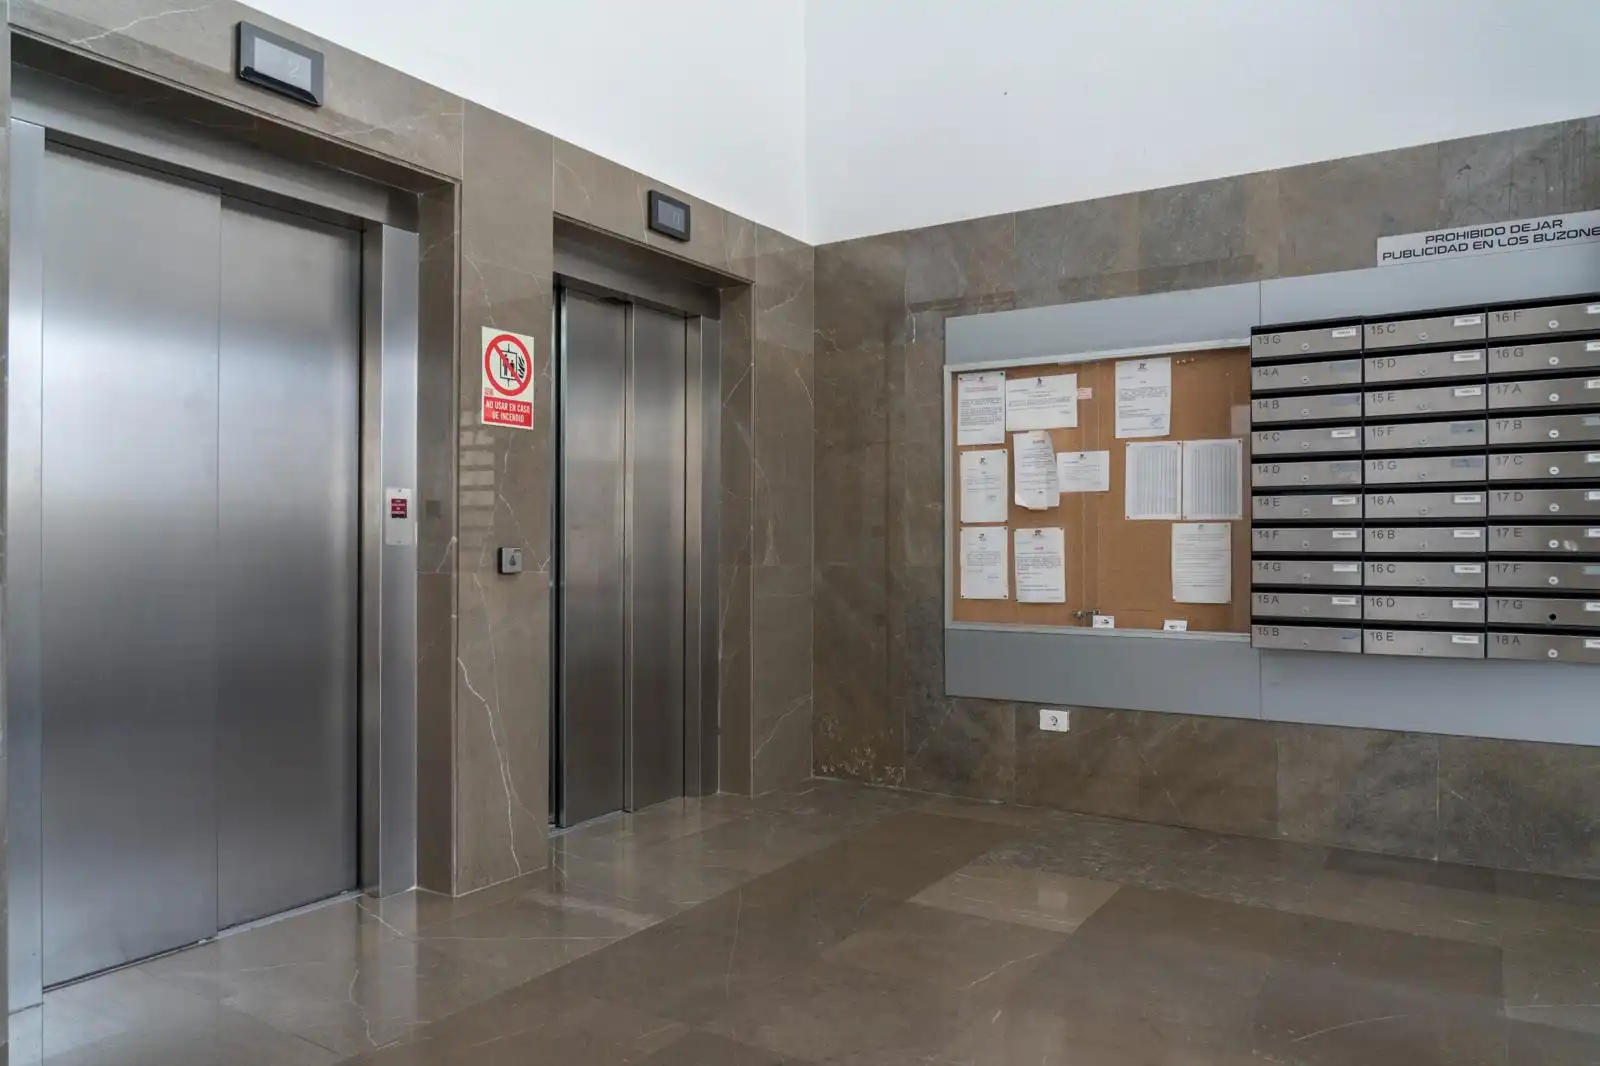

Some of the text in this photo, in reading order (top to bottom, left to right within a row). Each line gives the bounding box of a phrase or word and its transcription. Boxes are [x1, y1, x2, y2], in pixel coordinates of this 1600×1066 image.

[1425, 219, 1563, 244] PROHIBIDO DEJAR
[1382, 226, 1600, 260] PUBLICIDAD EN LOS BUZONE
[1495, 312, 1523, 323] 16 F
[1371, 324, 1396, 334] 15 C
[1495, 348, 1524, 359] 16 G
[1371, 359, 1396, 369] 15 D
[1257, 368, 1279, 377] 14 A
[1495, 384, 1522, 395] 17 A
[1371, 392, 1395, 403] 15 E
[486, 400, 530, 413] NO USAR EN CASO
[1257, 400, 1279, 409] 14 B
[492, 410, 524, 422] DE INCENDIO
[1496, 420, 1522, 429] 17 B
[1371, 427, 1395, 437] 15 F
[1258, 432, 1280, 442] 14 C
[1496, 456, 1524, 465] 17 C
[1258, 465, 1280, 474] 14 D
[1371, 461, 1396, 470] 15 G
[1387, 496, 1395, 505] A
[1496, 492, 1524, 501] 17 D
[1258, 498, 1280, 506] 14 E
[1258, 531, 1279, 539] 14 F
[1371, 530, 1395, 539] 16 B
[1496, 528, 1523, 537] 17 E
[1258, 563, 1281, 571] 14 G
[1371, 564, 1396, 573] 16 C
[1495, 564, 1521, 573] 17 F
[1258, 595, 1280, 604] 15 A
[1370, 597, 1395, 607] 16 D
[1495, 600, 1523, 609] 17 G
[1258, 628, 1279, 636] 15 B
[1370, 632, 1394, 642] 16 E
[1495, 636, 1521, 645] 18 A
